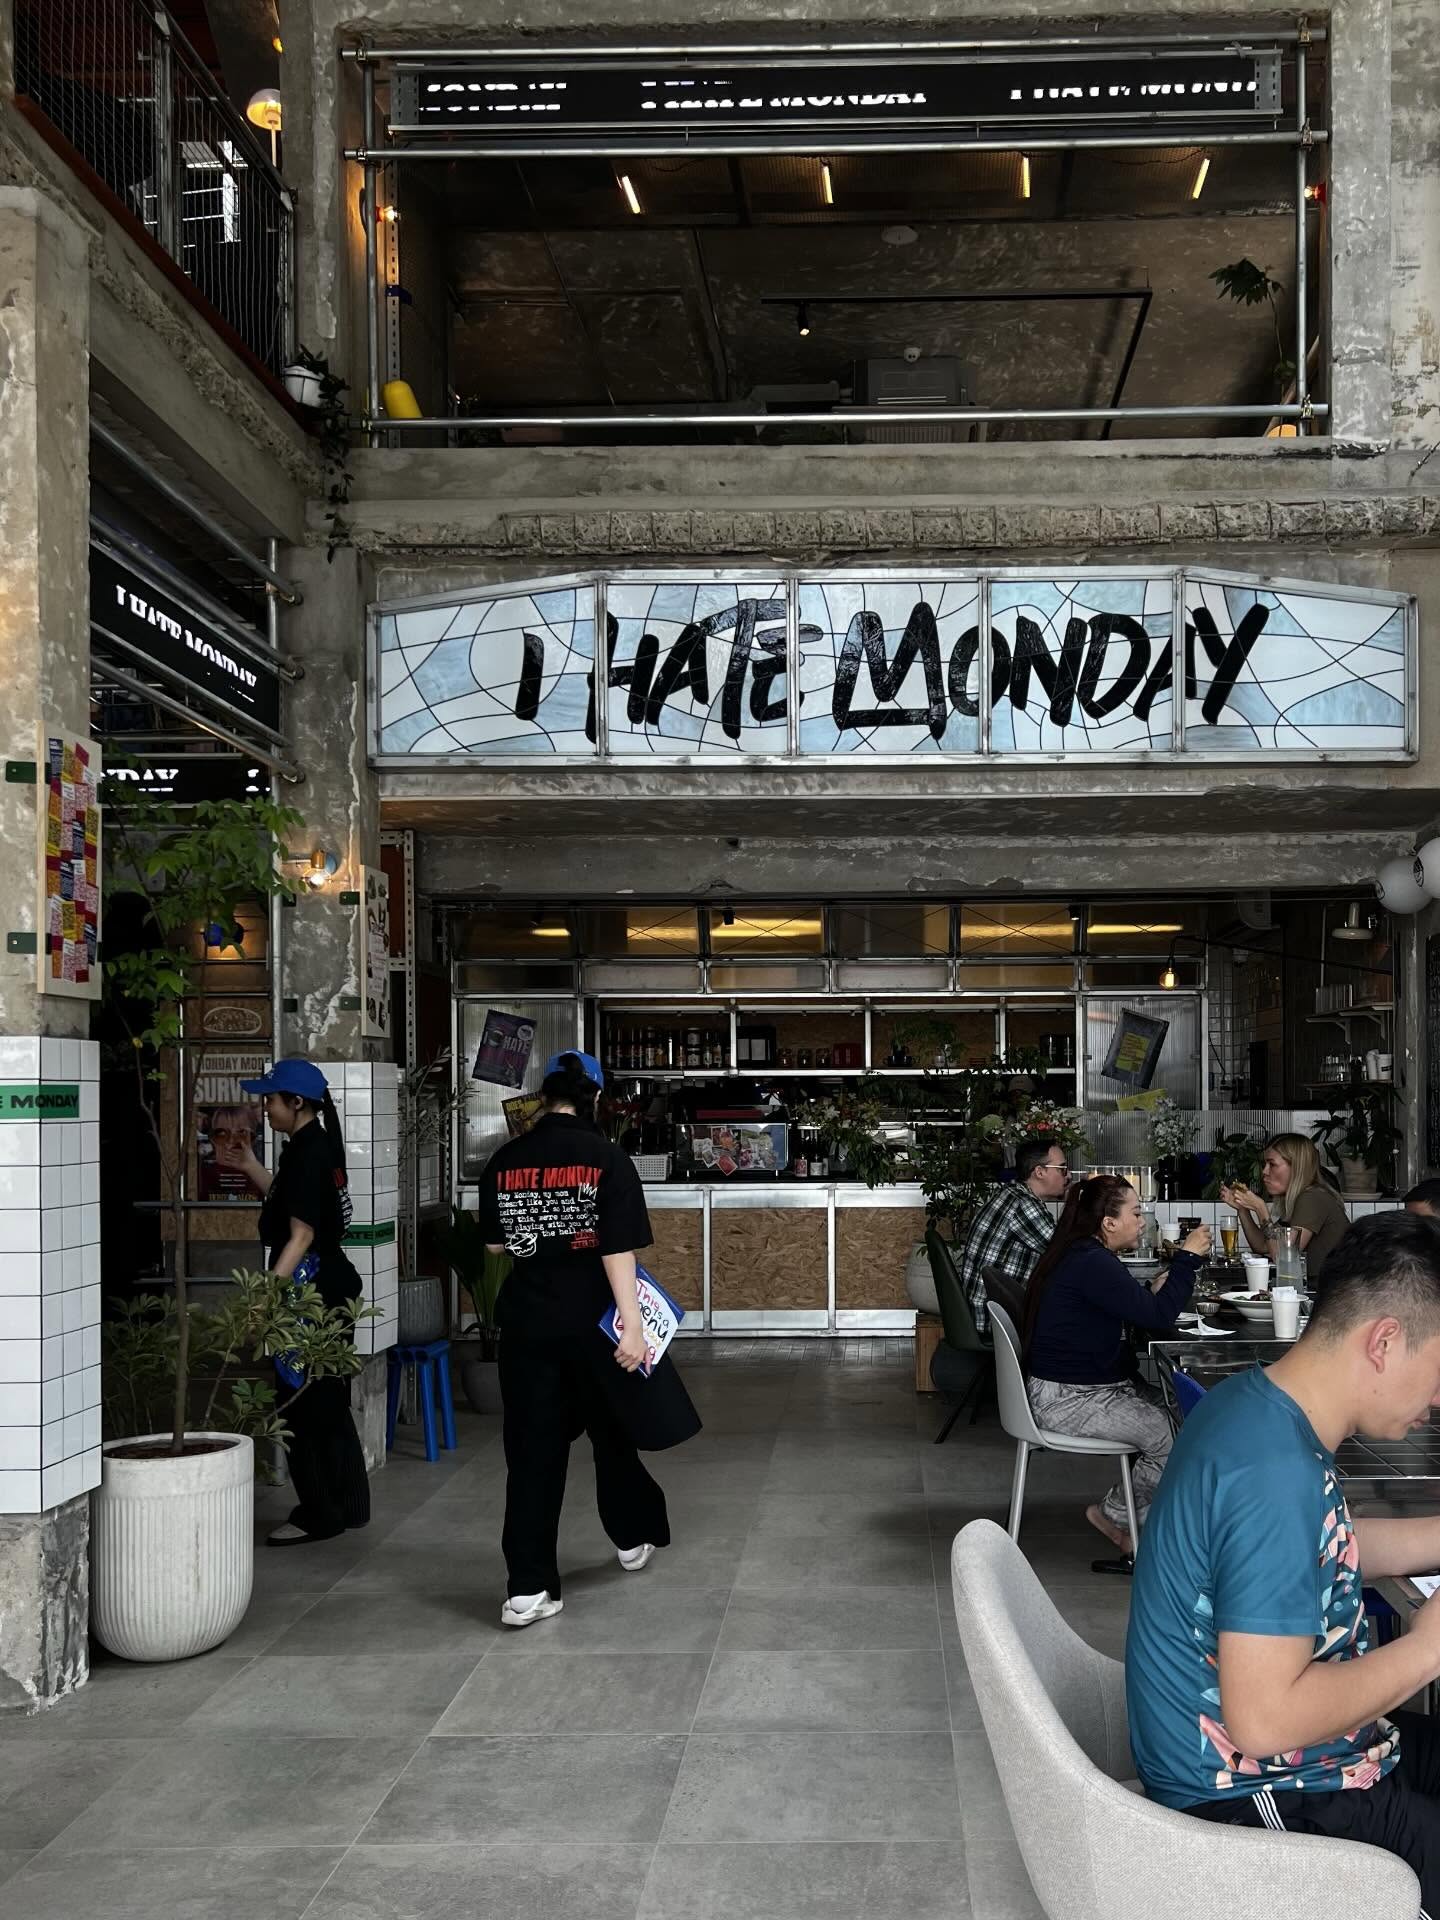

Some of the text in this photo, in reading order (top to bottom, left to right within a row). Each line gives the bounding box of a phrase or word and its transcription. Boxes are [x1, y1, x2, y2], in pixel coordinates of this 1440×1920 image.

[515, 598, 1270, 745] I HATE MONDAY
[503, 1036, 530, 1056] HATE
[11, 1094, 78, 1109] MONDAY
[497, 1166, 603, 1192] I HATE MONDAY
[497, 1192, 511, 1201] Hey
[526, 1198, 543, 1207] like
[545, 1199, 558, 1207] you
[560, 1196, 576, 1205] and
[499, 1208, 528, 1217] neither
[529, 1206, 539, 1214] do
[514, 1222, 545, 1233] playing
[547, 1220, 566, 1229] with
